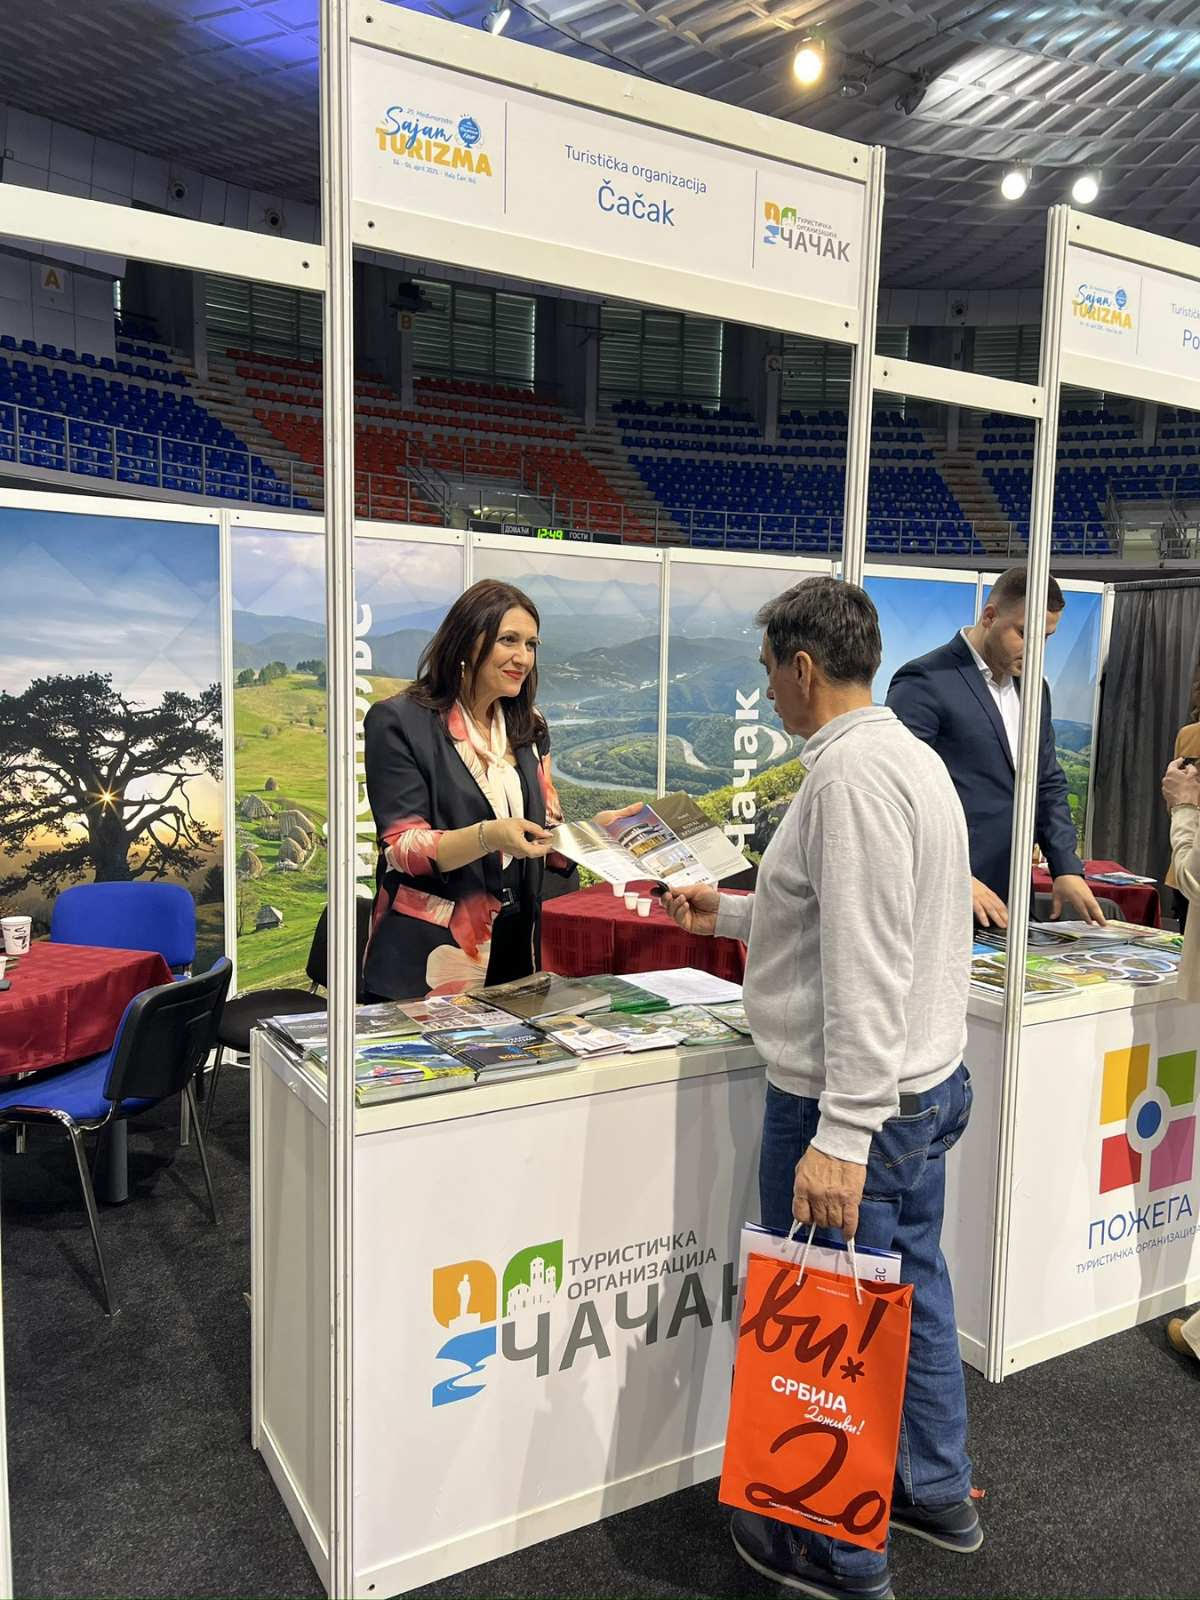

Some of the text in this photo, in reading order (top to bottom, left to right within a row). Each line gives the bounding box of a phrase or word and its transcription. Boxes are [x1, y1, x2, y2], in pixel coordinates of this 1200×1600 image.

[382, 105, 452, 150] Sajam
[375, 127, 493, 177] TURIZMA
[564, 144, 707, 195] Turistička organizacija
[597, 178, 675, 227] Čačak
[780, 227, 851, 263] ЧАЧАК
[1072, 299, 1133, 329] TURIZMA
[1088, 1194, 1193, 1250] ПОЖЕГА
[567, 1230, 697, 1276] ТУРИСТИЧКА
[567, 1247, 717, 1300] ОРГАНИЗАЦИЈА
[1075, 1246, 1134, 1274] ТУРИСТИЧКА
[771, 1375, 848, 1414] СРБИЈА
